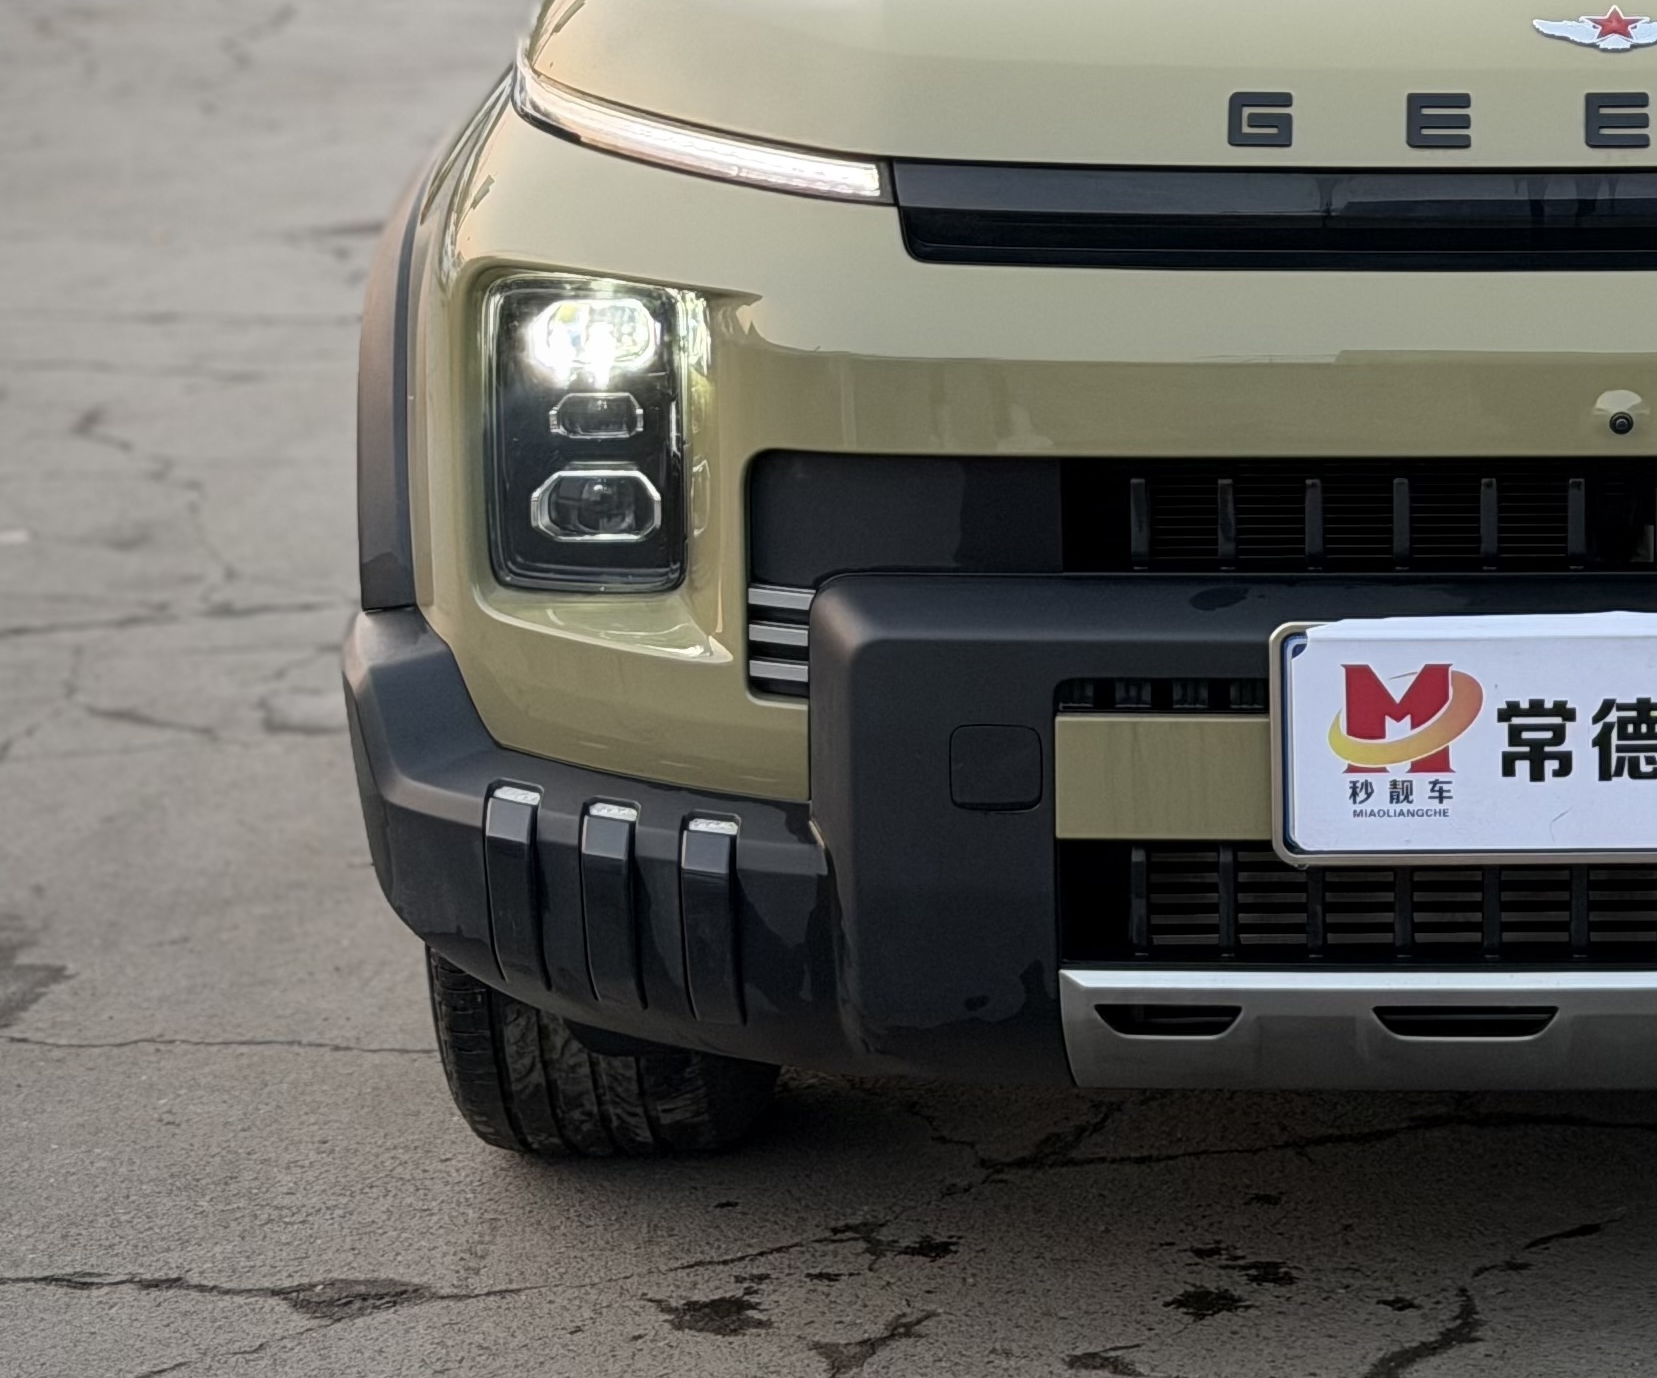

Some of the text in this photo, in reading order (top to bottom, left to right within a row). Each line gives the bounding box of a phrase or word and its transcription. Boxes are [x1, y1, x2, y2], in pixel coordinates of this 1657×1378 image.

[1348, 778, 1454, 805] 秒靓车
[1352, 808, 1450, 819] MIAOLIANGCHE
